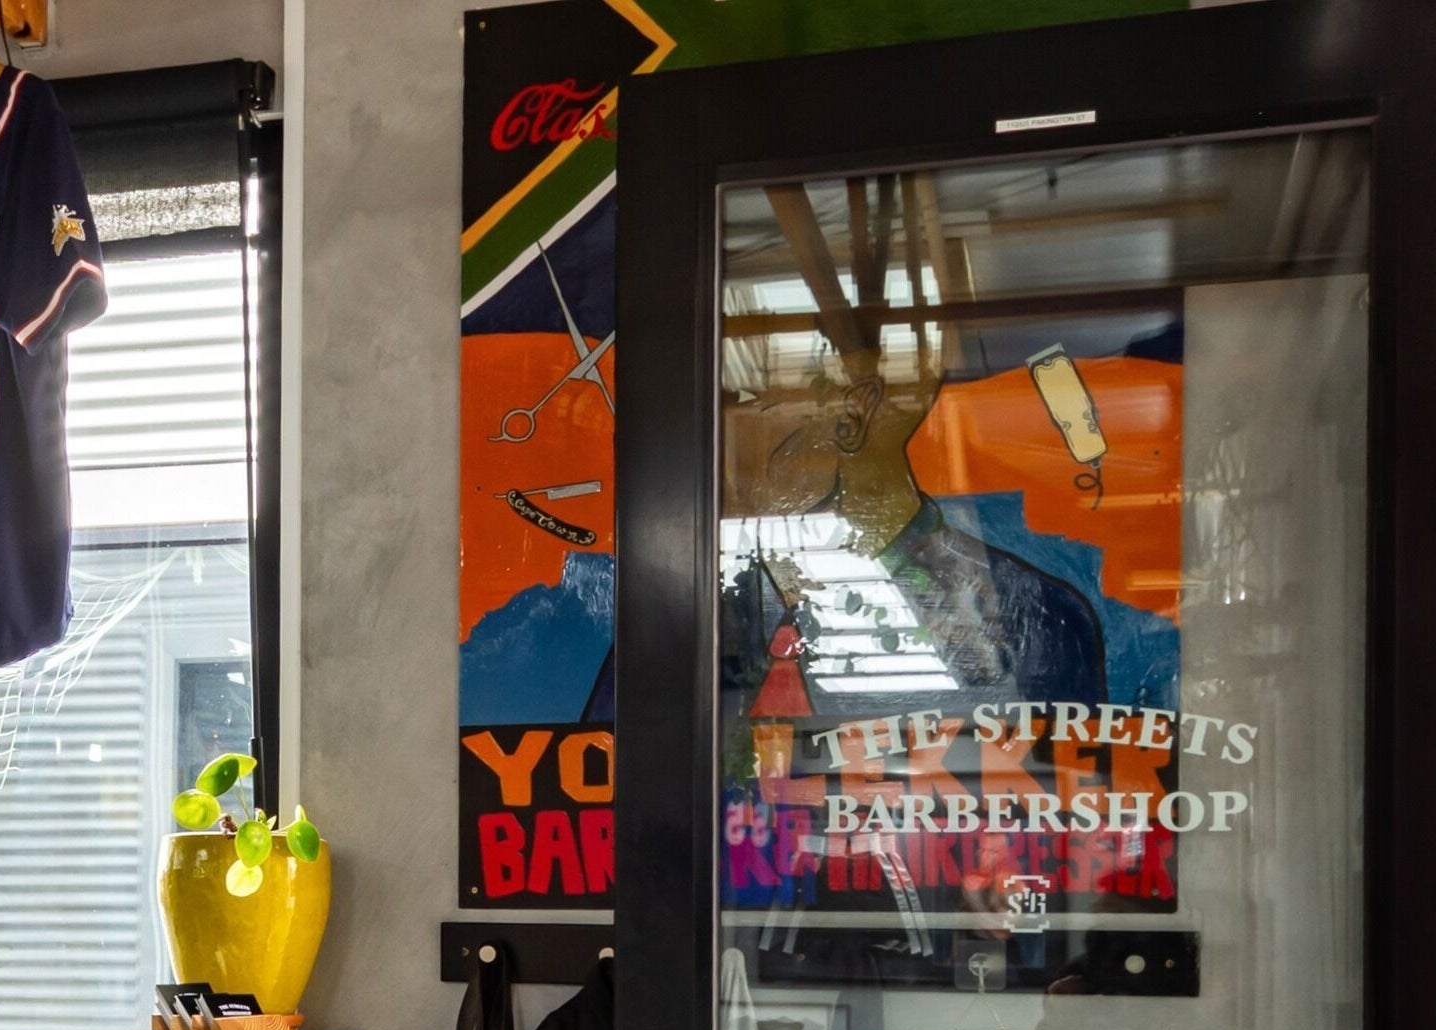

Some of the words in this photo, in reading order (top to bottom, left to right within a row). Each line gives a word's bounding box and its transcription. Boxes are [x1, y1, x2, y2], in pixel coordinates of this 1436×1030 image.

[811, 708, 949, 769] THE
[972, 701, 1259, 765] STREETS
[823, 790, 1249, 833] BARBERSHOP
